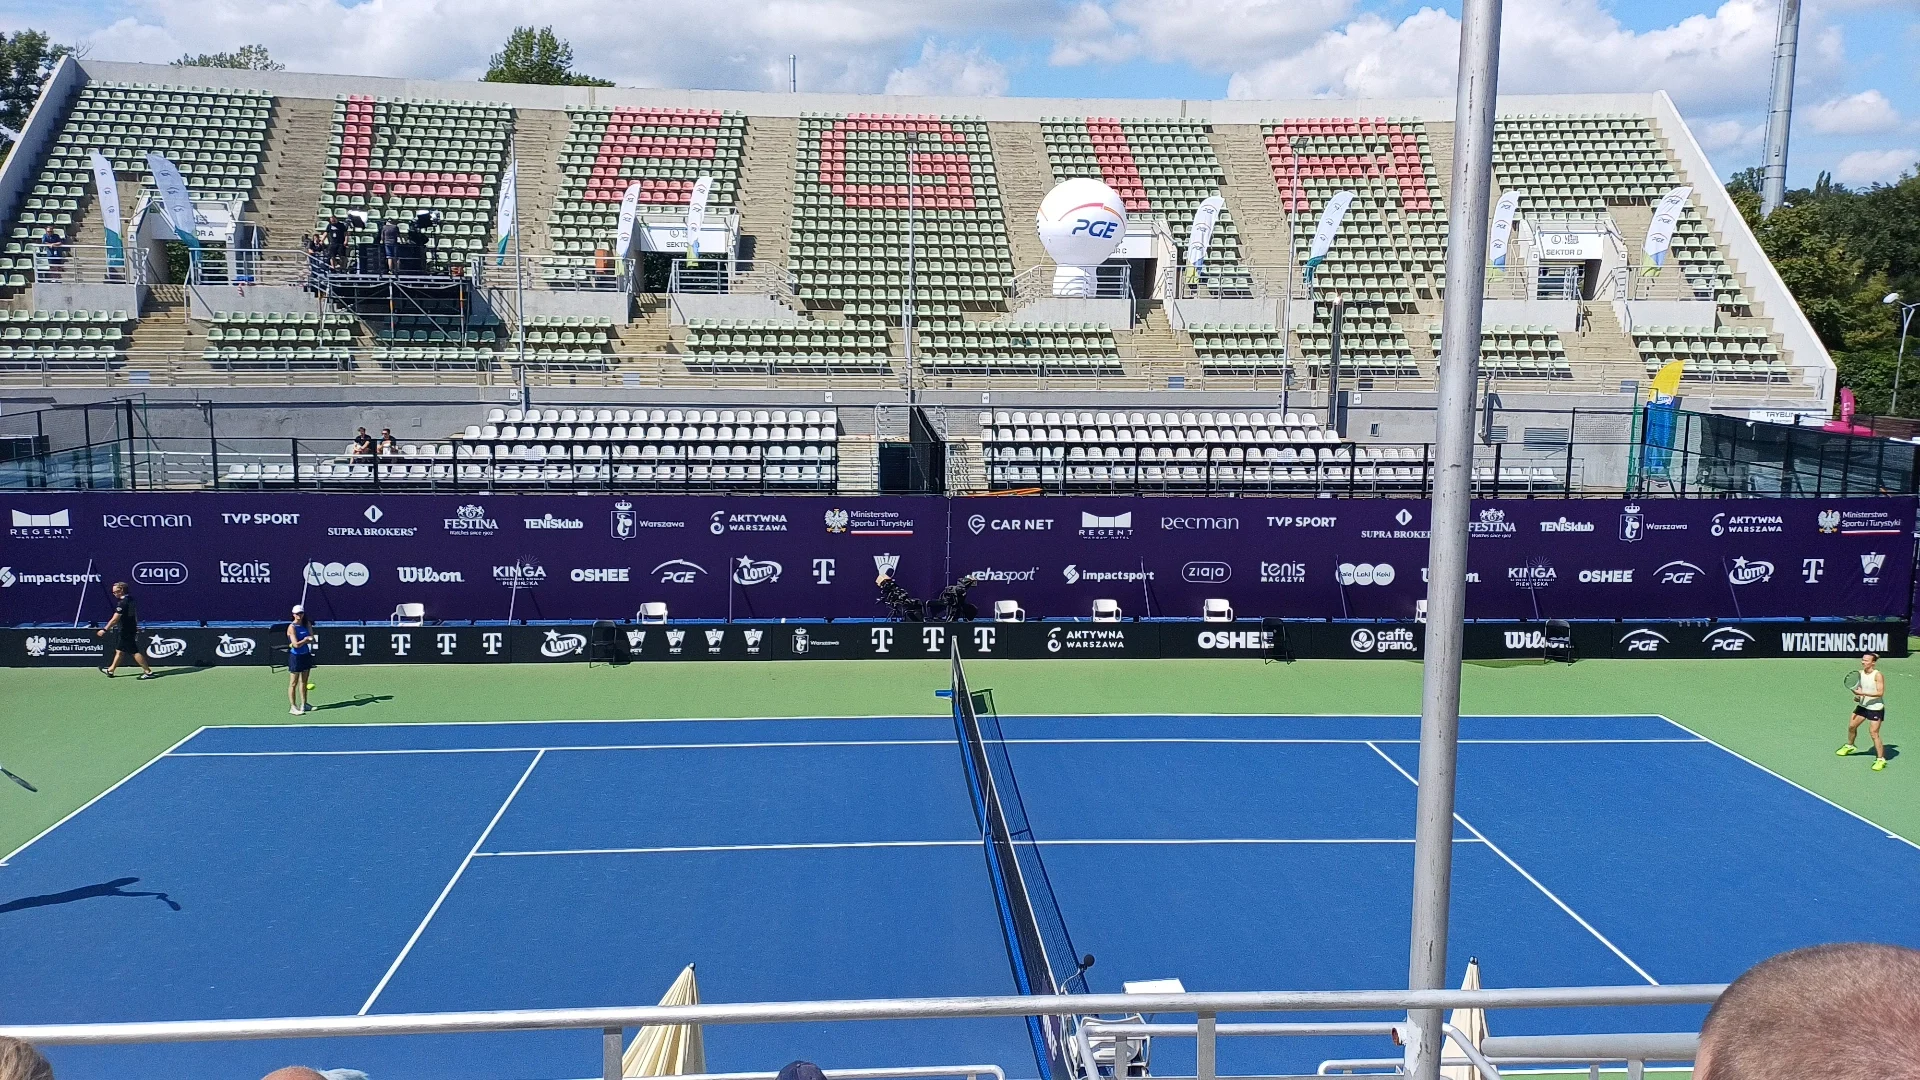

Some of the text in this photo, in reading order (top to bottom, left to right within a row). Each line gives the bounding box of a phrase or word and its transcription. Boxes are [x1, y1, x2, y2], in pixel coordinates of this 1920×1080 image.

[1072, 219, 1118, 239] PGE
[221, 513, 300, 524] TVP SPORT
[729, 514, 788, 523] AKTYWNA
[851, 510, 899, 518] Ministerstwo
[444, 518, 499, 529] FESTINA
[851, 519, 875, 527] Sportu
[880, 519, 914, 527] Turystyki
[991, 519, 1054, 530] CAR NET
[1267, 517, 1337, 527] TVP SPORT
[1729, 516, 1783, 524] AKTYWNA
[1870, 519, 1901, 527] Turystyki
[328, 527, 362, 535] SUPRA
[1468, 522, 1517, 532] FESTINA
[1361, 530, 1392, 538] SUPRA
[220, 560, 270, 576] tenis
[743, 565, 773, 580] LOTTO
[1189, 567, 1224, 580] ziaja
[1261, 560, 1305, 576] tenis
[1738, 565, 1765, 580] LOTTO
[19, 572, 102, 585] impactsport
[139, 567, 180, 581] ziaja
[571, 568, 629, 582] OSHEE
[661, 572, 696, 583] PGE
[1082, 570, 1154, 583] impactsport
[1579, 570, 1633, 582] OSHEE
[1661, 572, 1695, 583] PGE
[1066, 630, 1125, 639] AKTYWNA
[1377, 628, 1413, 640] caffe
[48, 636, 91, 644] Ministerstwo
[549, 638, 578, 652] LOTTO
[1628, 640, 1659, 651] PGE
[1711, 638, 1745, 651] PGE
[1782, 632, 1888, 652] WTATENNIS.COM
[48, 644, 71, 652] Sportu
[74, 644, 103, 652] Turystyki
[154, 642, 179, 654] LOTTO
[224, 641, 249, 654] LOTTO
